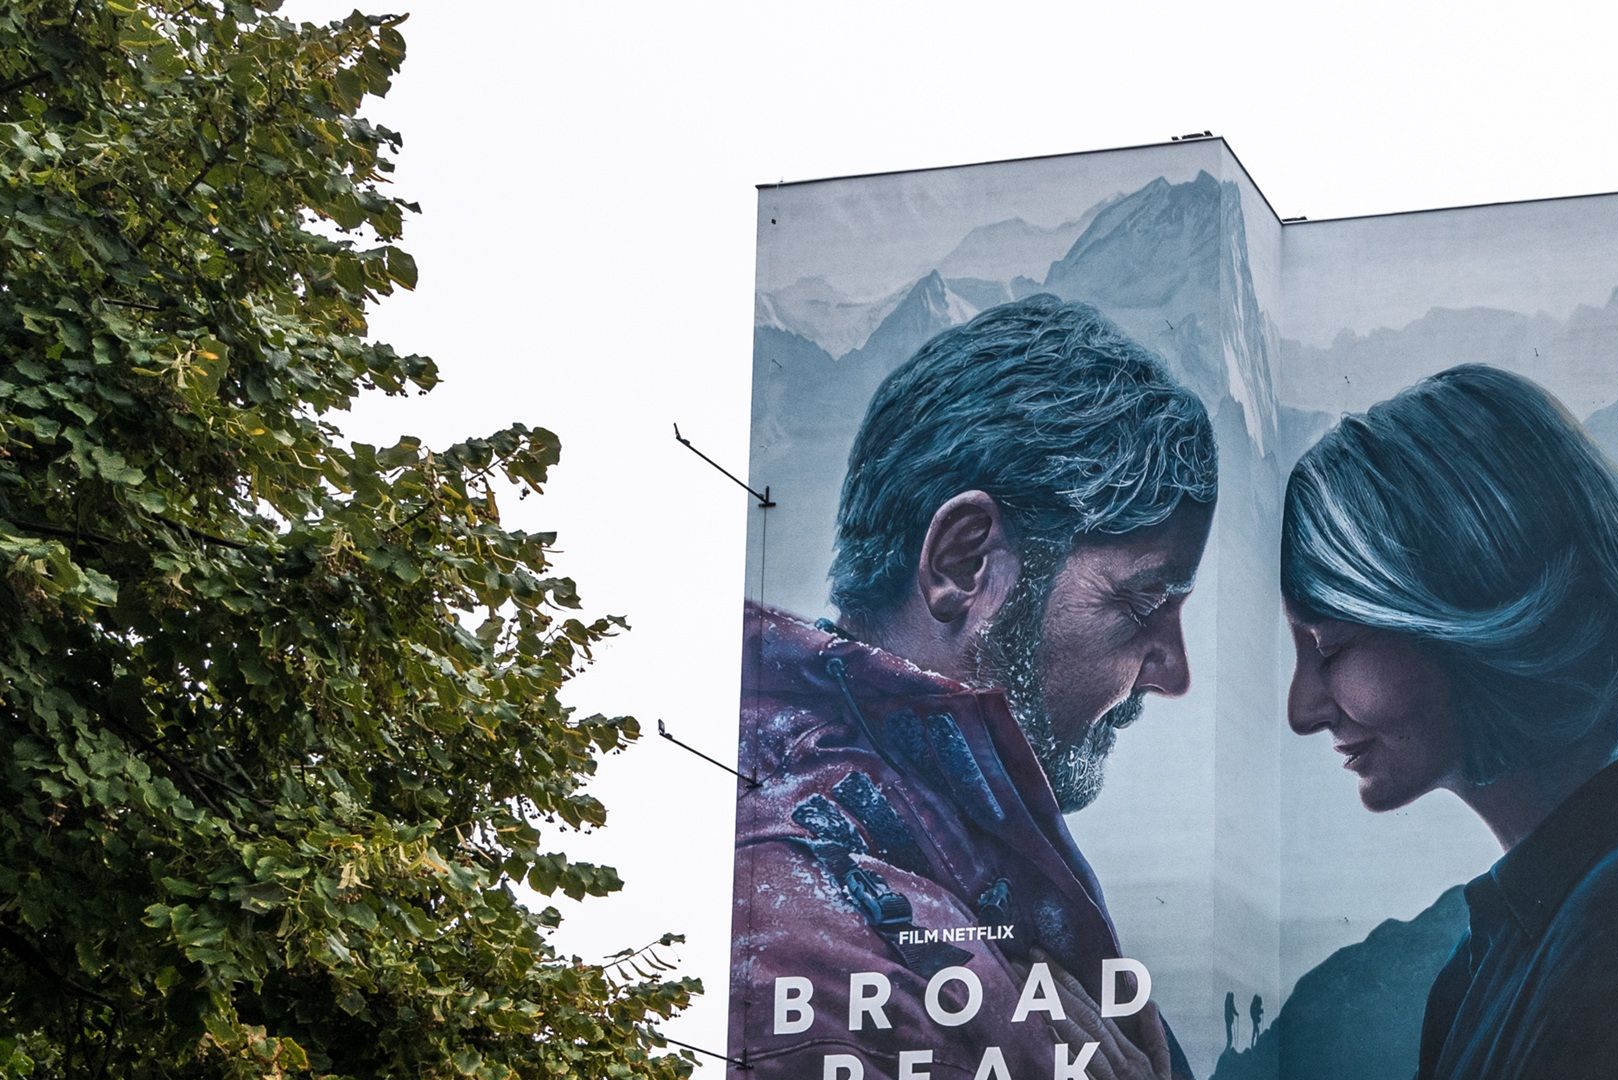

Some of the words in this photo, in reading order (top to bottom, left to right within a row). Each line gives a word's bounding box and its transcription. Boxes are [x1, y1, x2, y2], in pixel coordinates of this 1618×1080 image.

[899, 929, 938, 945] FILM
[943, 924, 1014, 943] NETFLIX
[773, 958, 1152, 1035] BROAD
